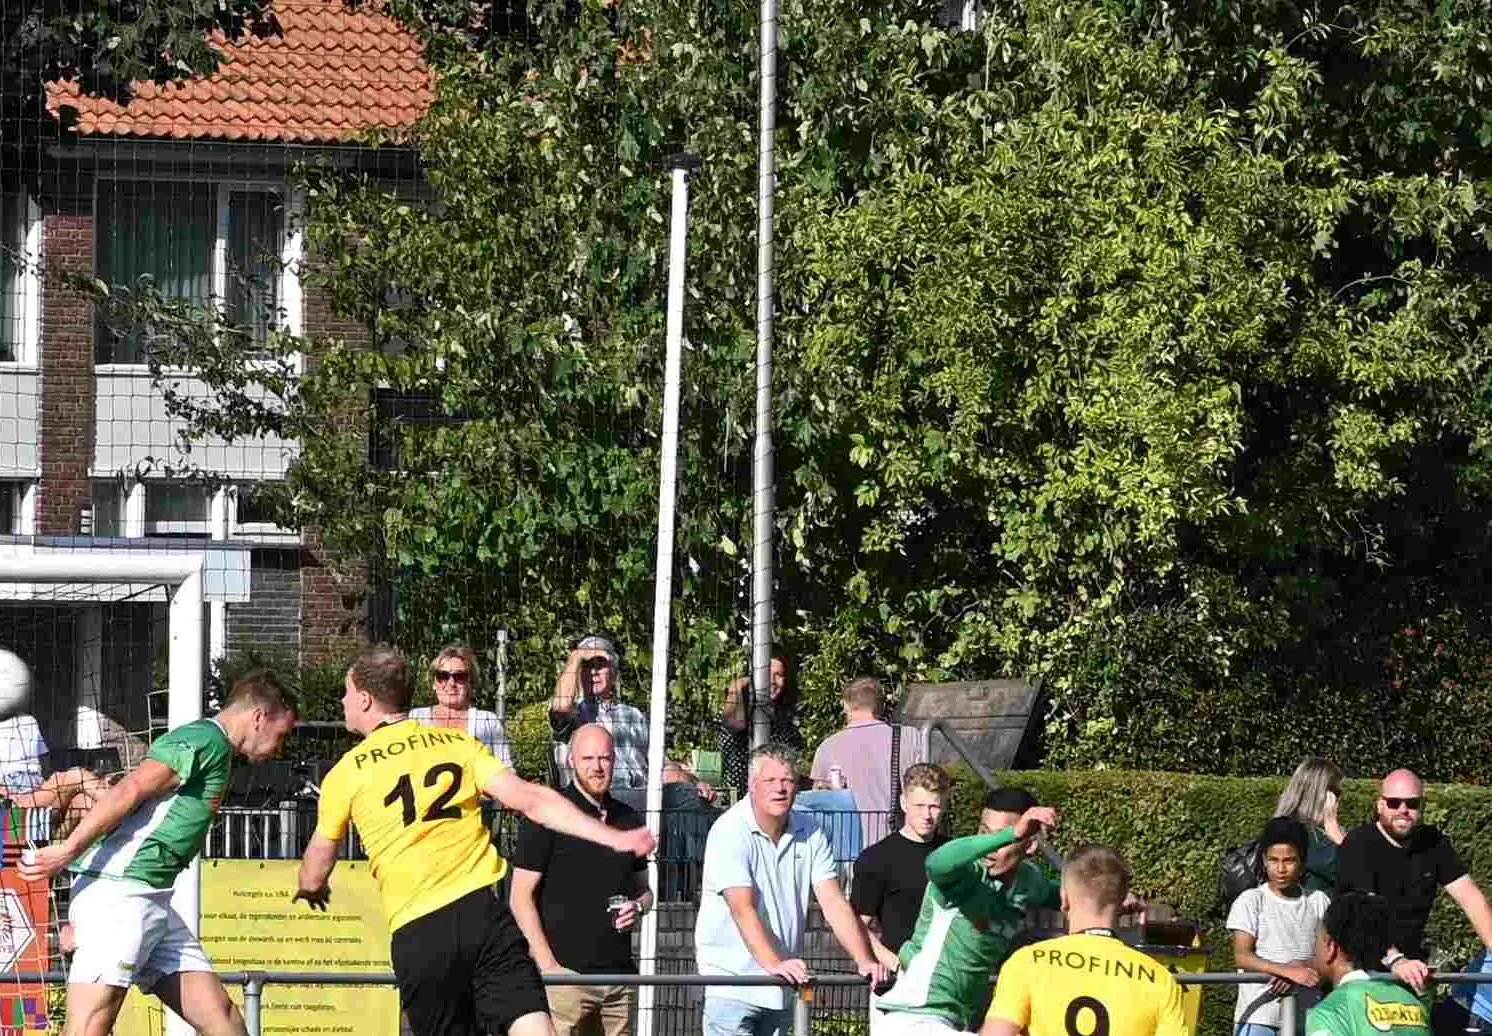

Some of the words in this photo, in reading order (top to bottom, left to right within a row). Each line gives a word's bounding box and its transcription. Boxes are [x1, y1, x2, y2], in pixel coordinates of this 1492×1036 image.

[354, 732, 465, 770] PROFINN
[384, 762, 463, 827] 12
[1032, 949, 1156, 984] PROFINN
